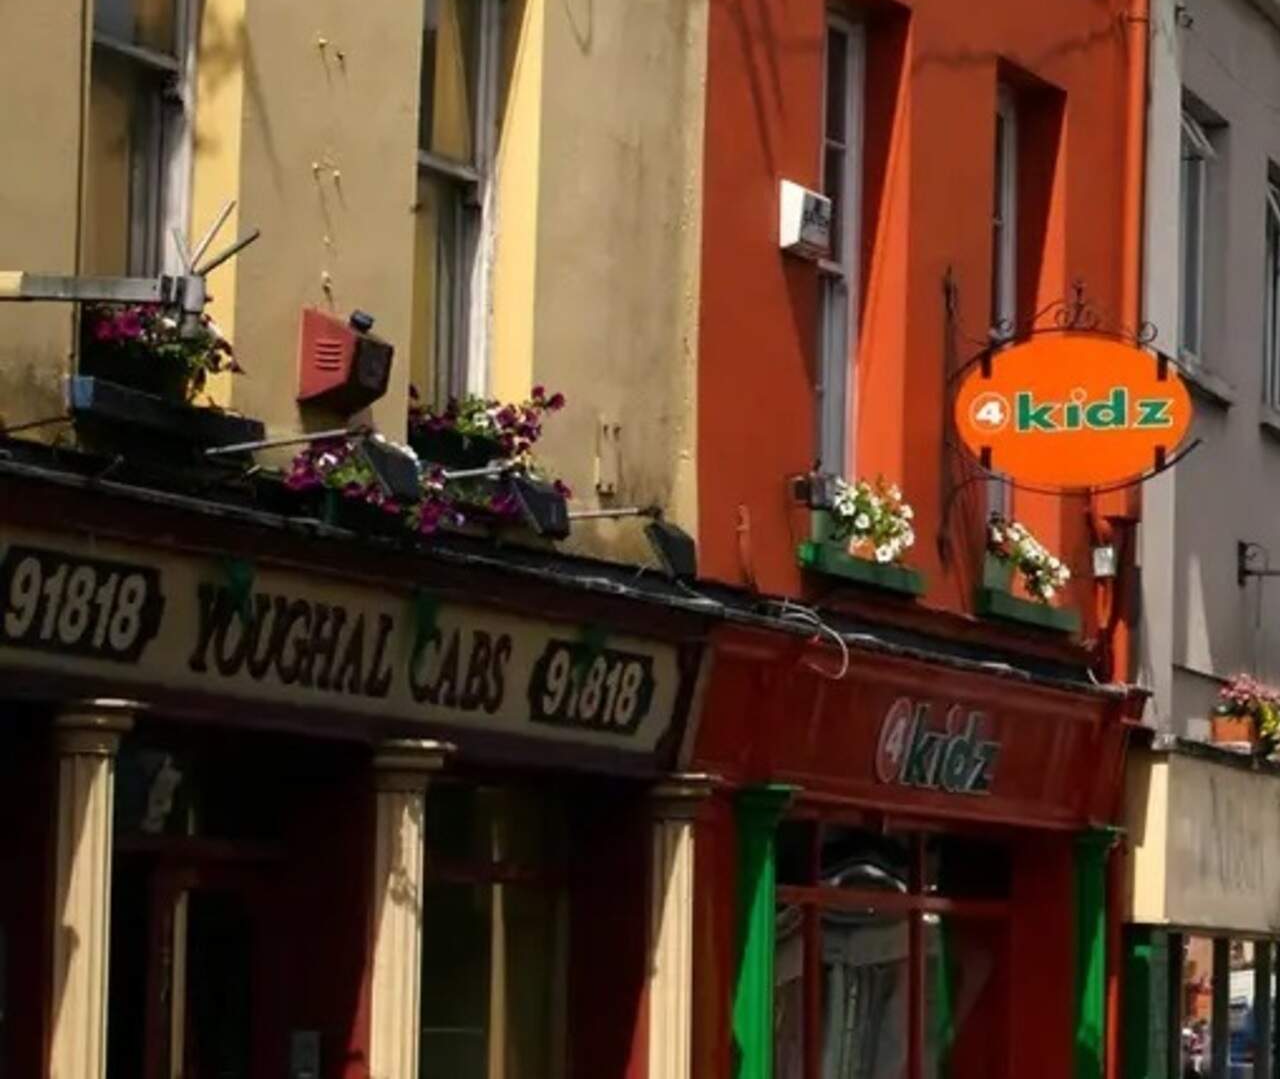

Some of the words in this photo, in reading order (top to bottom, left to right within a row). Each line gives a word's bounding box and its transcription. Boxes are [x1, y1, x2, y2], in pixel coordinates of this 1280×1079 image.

[5, 556, 147, 652] 91818
[189, 583, 394, 698] YOUGHAL
[408, 626, 512, 714] CABS
